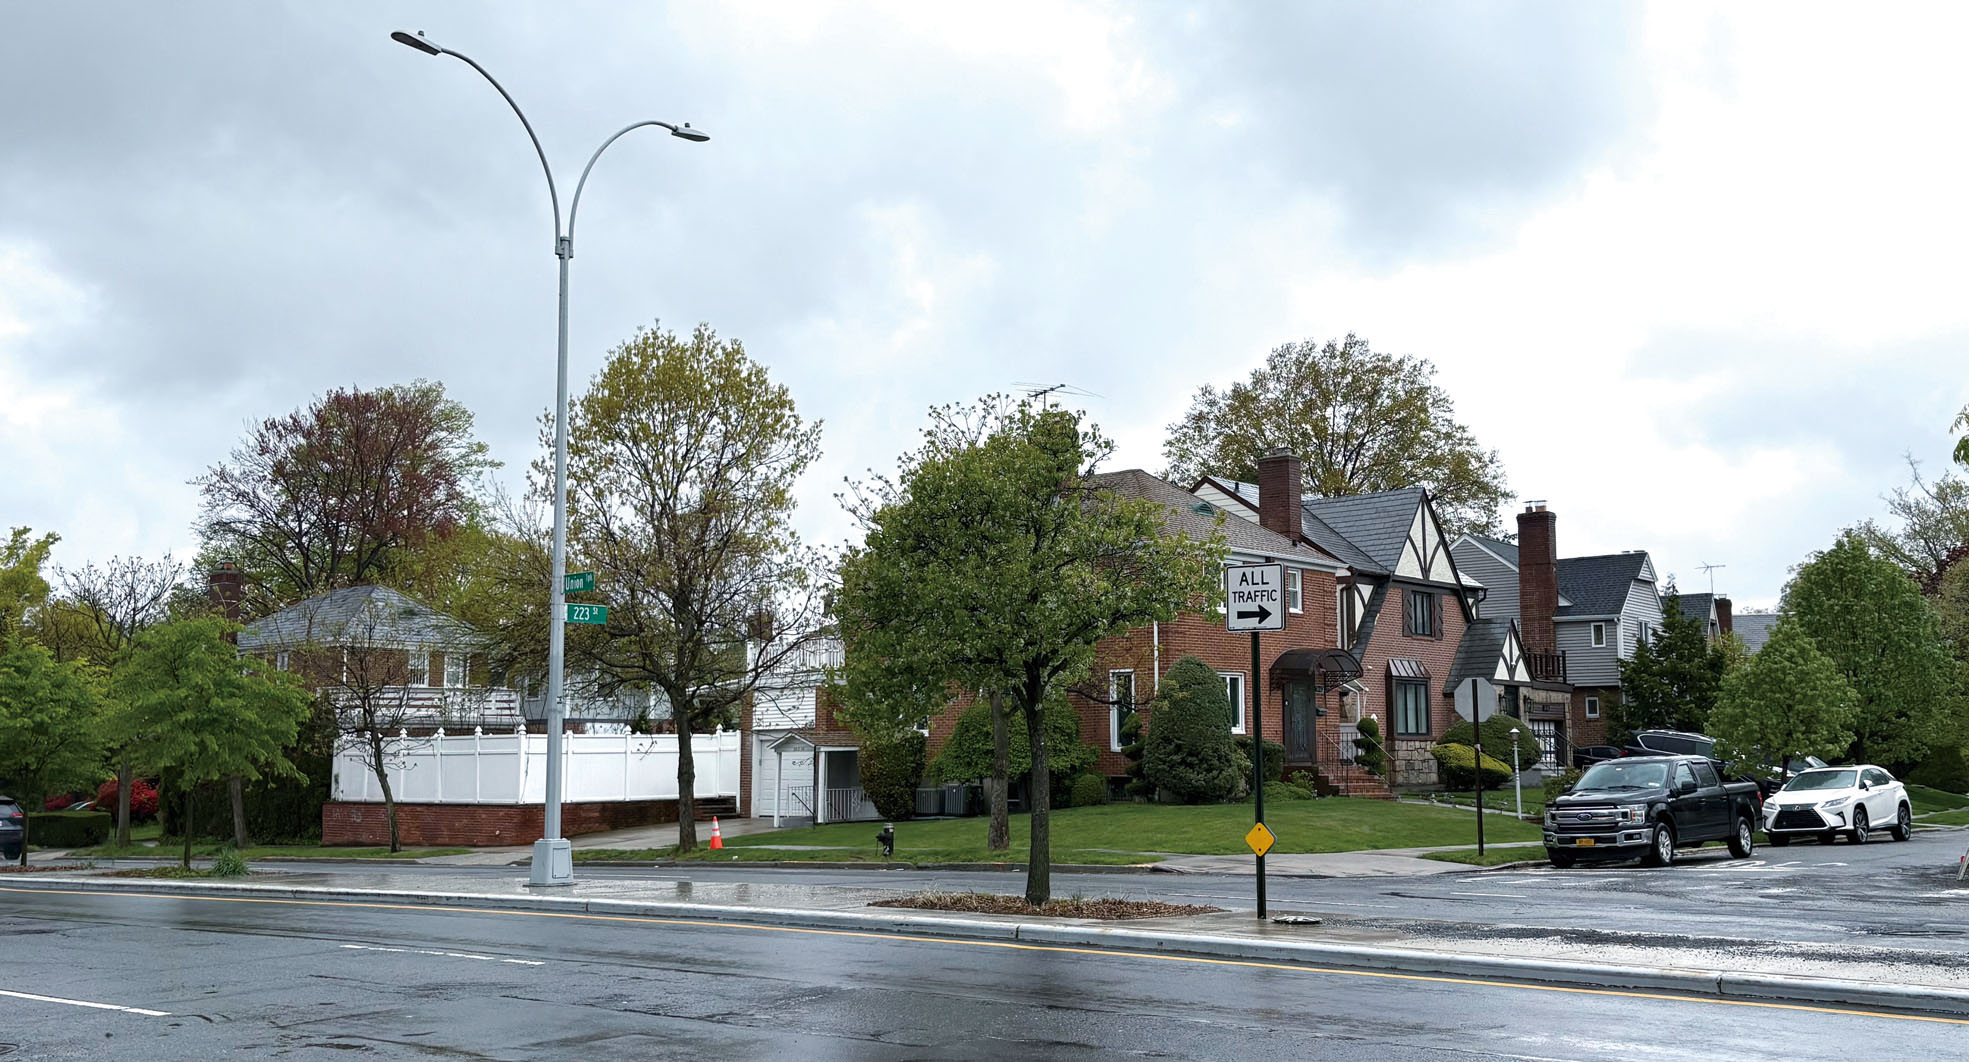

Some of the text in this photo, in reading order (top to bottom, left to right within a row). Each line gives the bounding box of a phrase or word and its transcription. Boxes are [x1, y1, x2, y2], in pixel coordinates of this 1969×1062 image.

[565, 575, 584, 590] Union
[1239, 570, 1269, 586] ALL
[1231, 589, 1277, 603] TRAFFIC
[573, 606, 590, 620] 223
